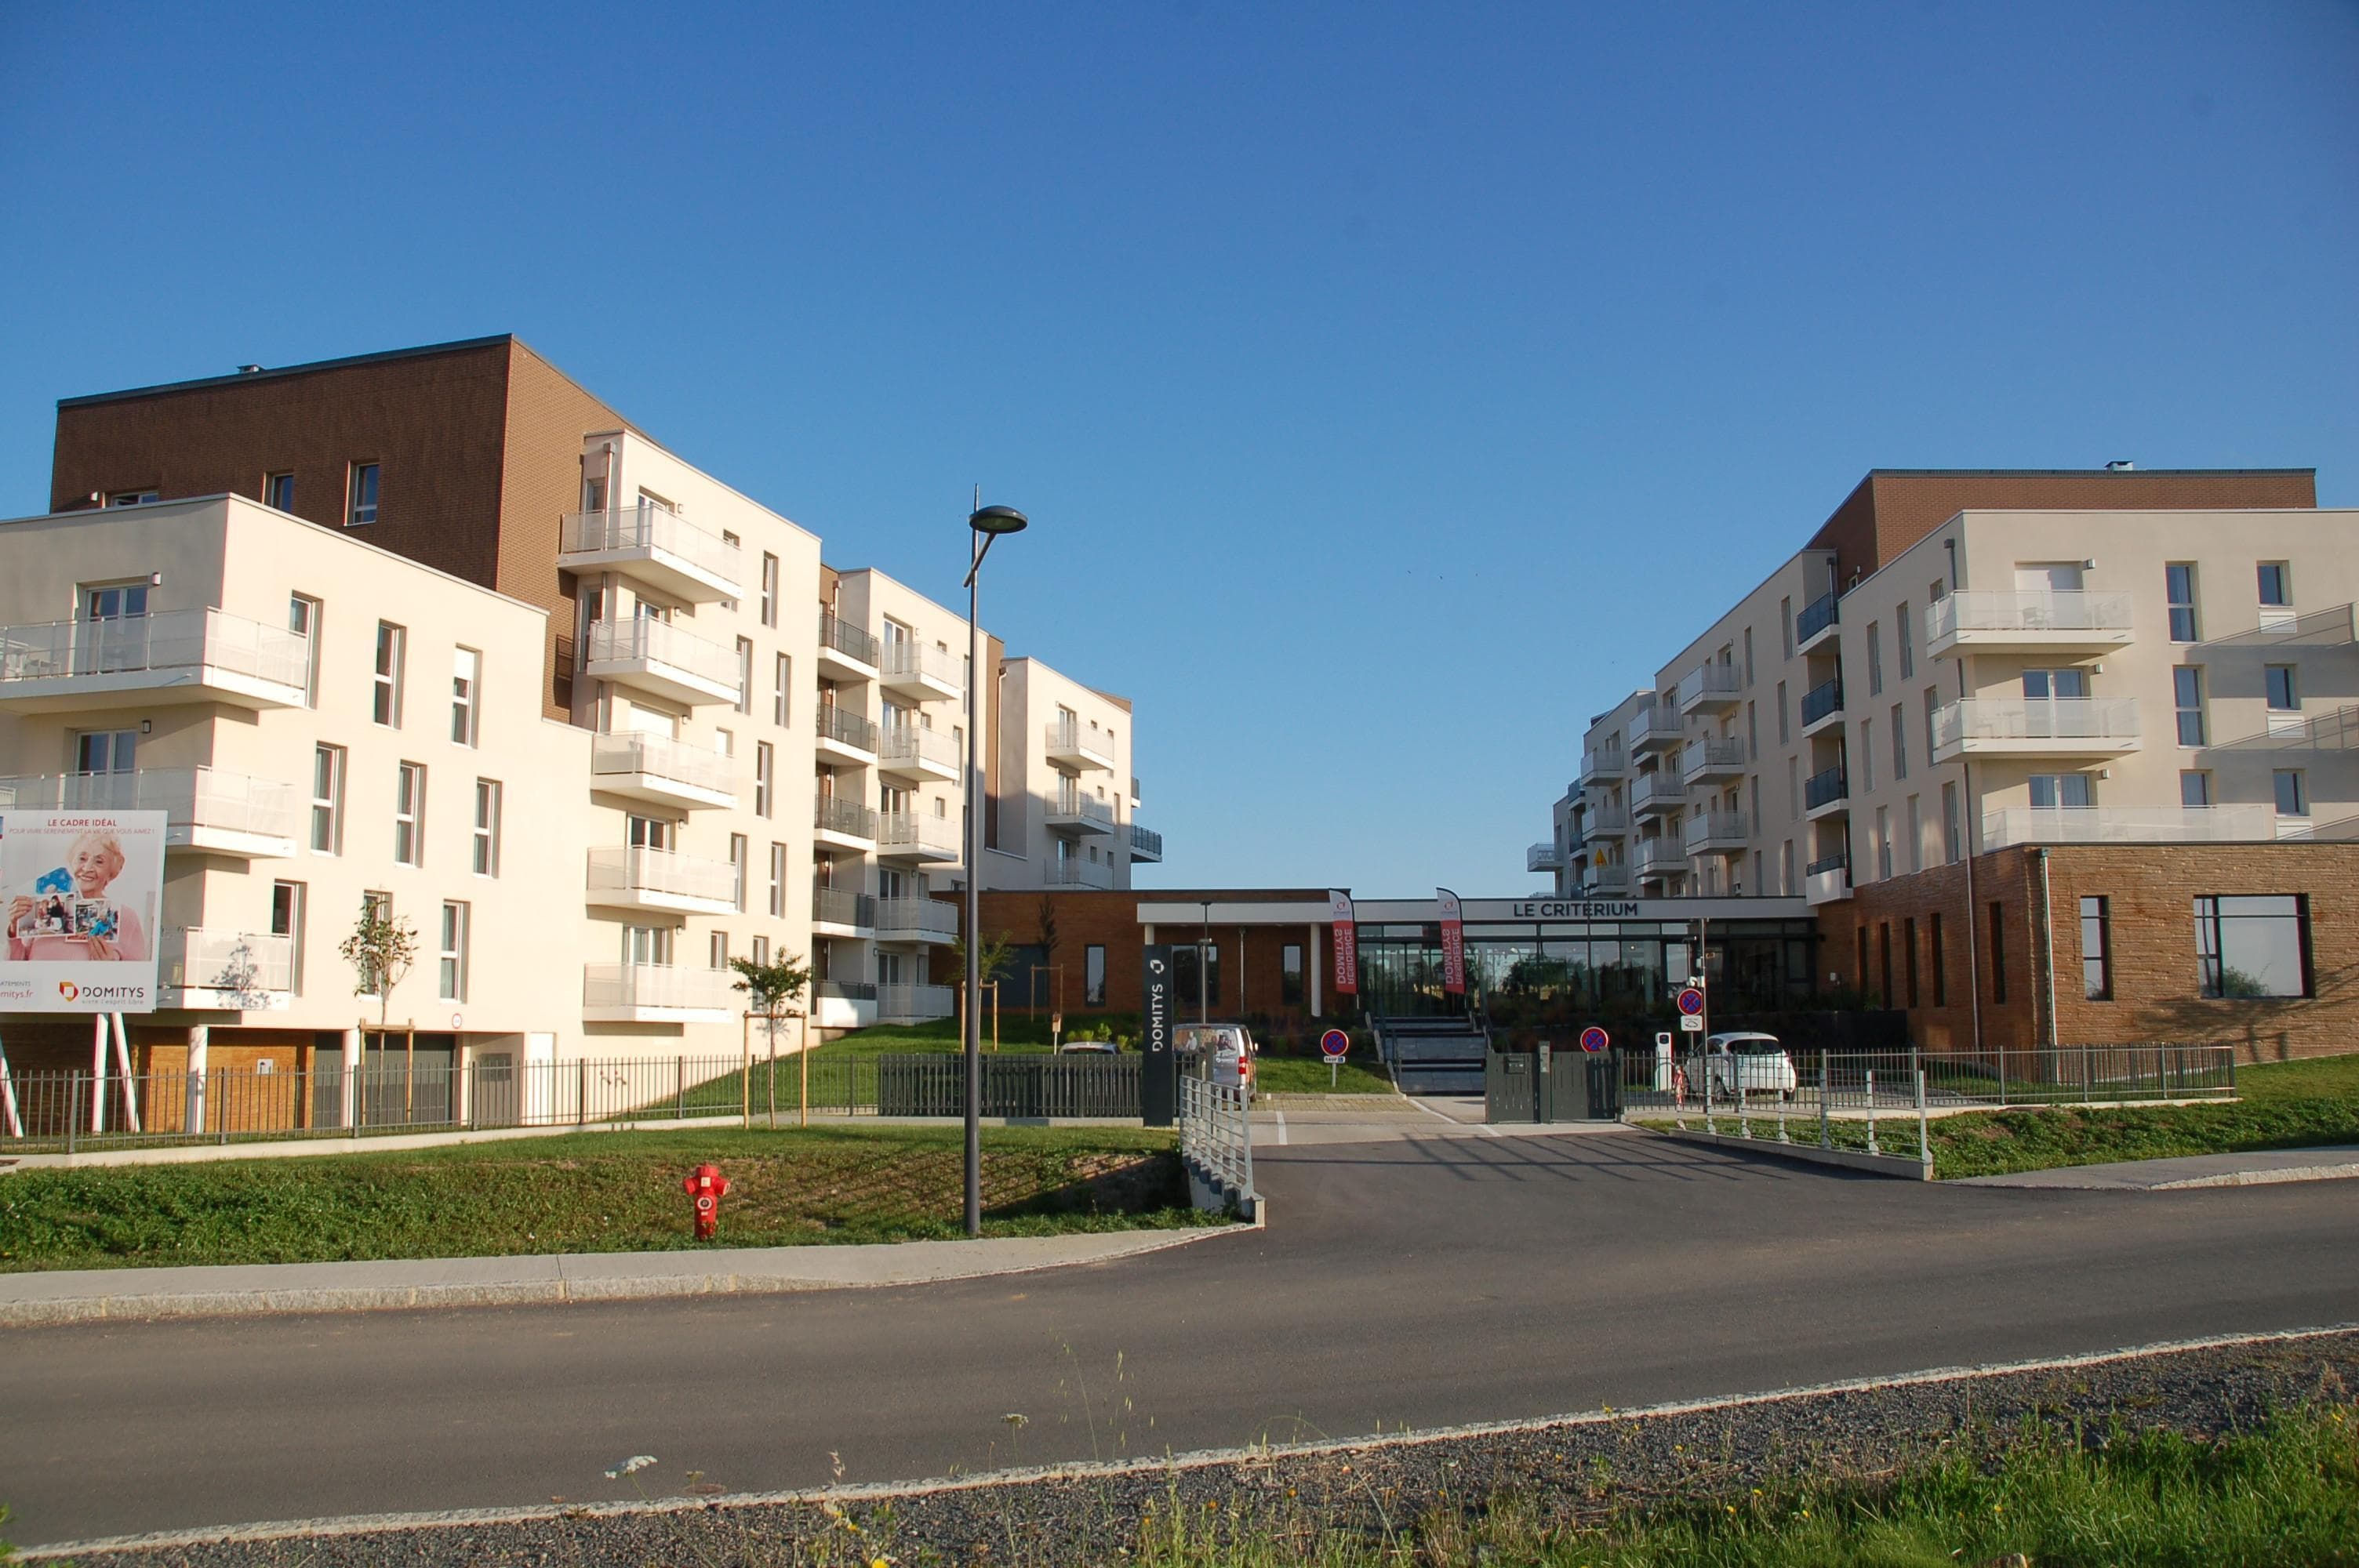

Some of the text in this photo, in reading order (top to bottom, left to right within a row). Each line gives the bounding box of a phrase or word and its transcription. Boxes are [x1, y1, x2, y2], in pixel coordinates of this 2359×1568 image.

[48, 817, 117, 827] LE CADRE IDÉAL
[1514, 902, 1638, 917] LE CRITERIUM
[82, 986, 144, 998] DOMITYS
[1151, 984, 1164, 1051] DOMITYS
